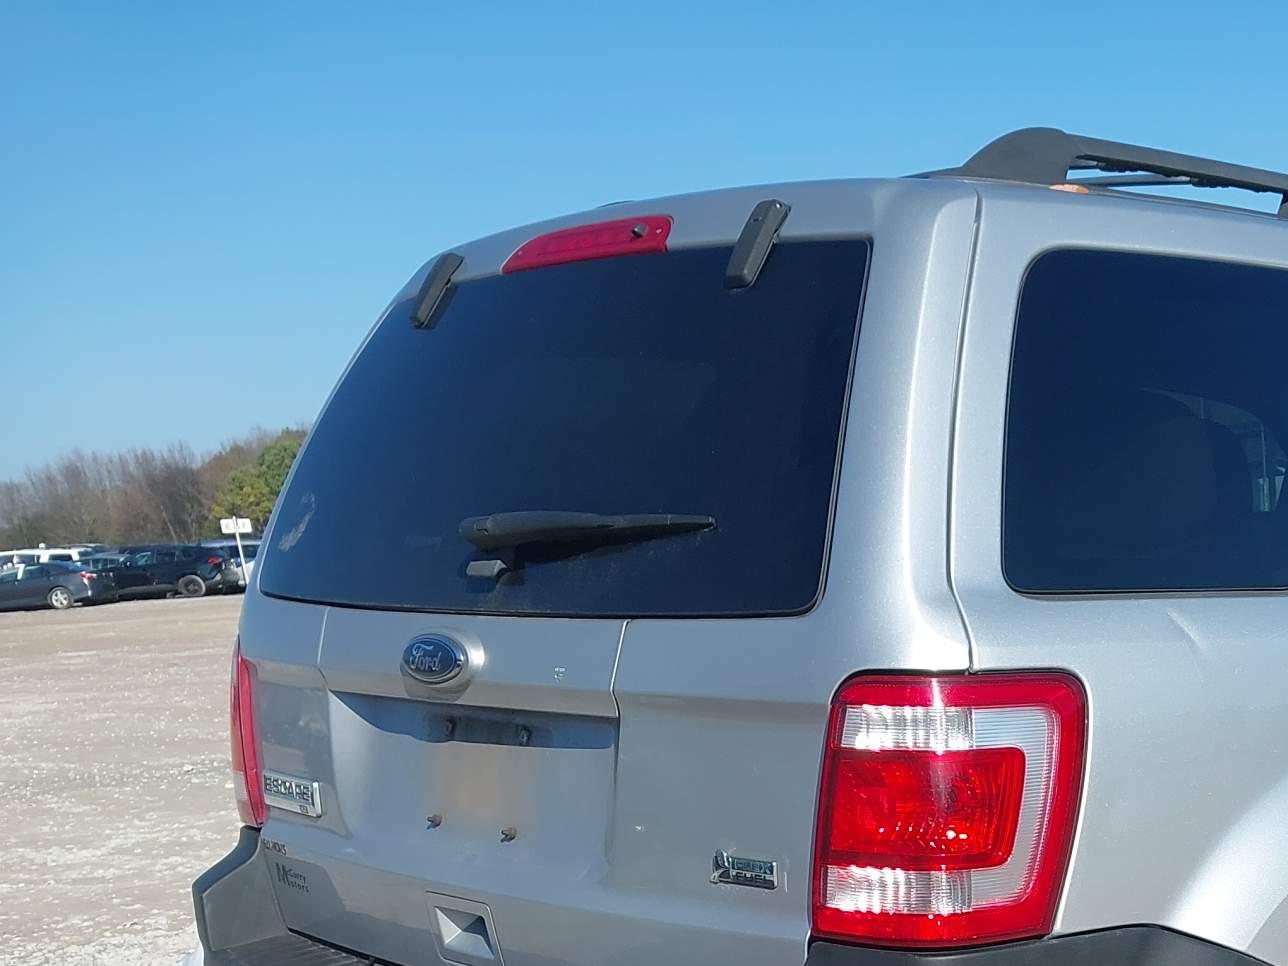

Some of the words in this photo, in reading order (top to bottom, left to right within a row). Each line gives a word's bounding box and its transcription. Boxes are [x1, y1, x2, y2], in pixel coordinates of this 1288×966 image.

[409, 642, 442, 672] Ford
[264, 776, 312, 803] ESCAPE
[732, 870, 774, 882] FUEL
[734, 858, 772, 874] FLEX
